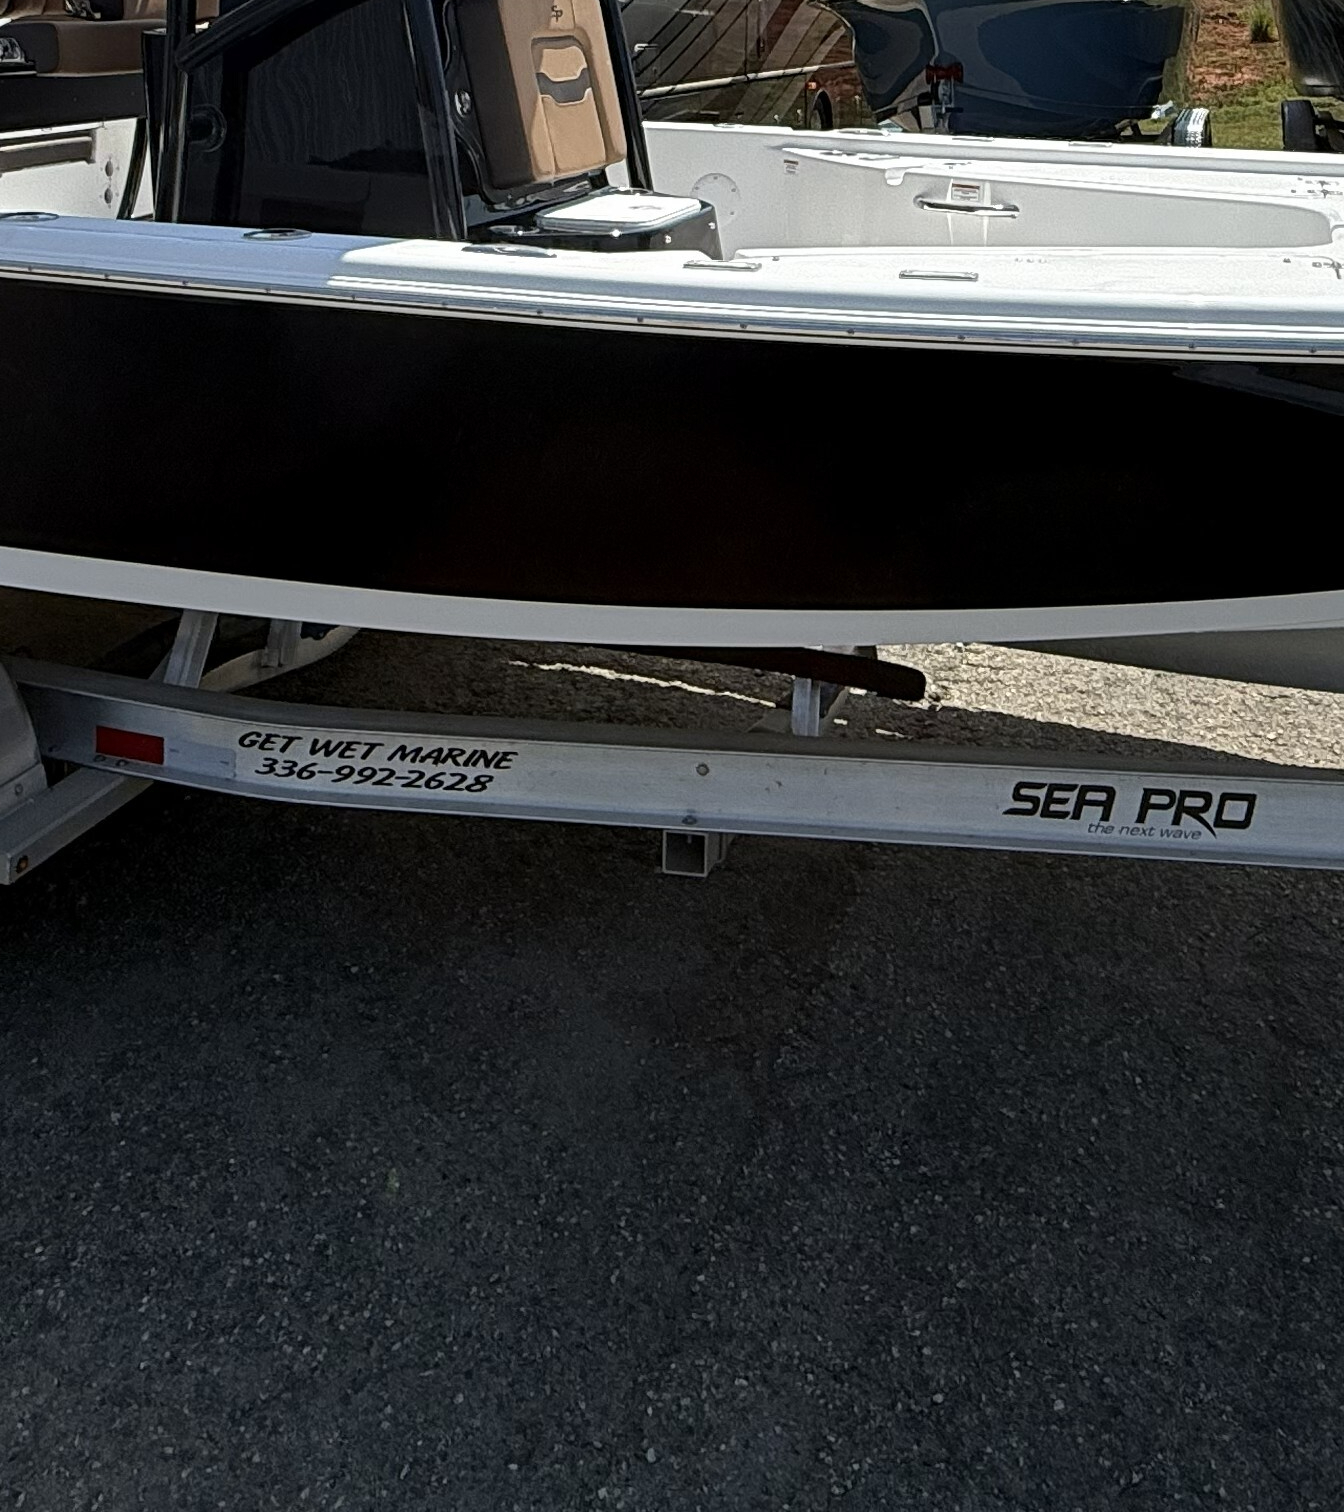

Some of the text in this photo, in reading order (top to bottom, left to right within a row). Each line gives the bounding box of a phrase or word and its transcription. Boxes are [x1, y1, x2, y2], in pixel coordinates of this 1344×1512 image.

[238, 731, 519, 770] GET WET MARINE
[255, 757, 494, 793] 336-992-2628
[1002, 781, 1257, 839] SEA PRO
[1087, 821, 1202, 840] the next wave
